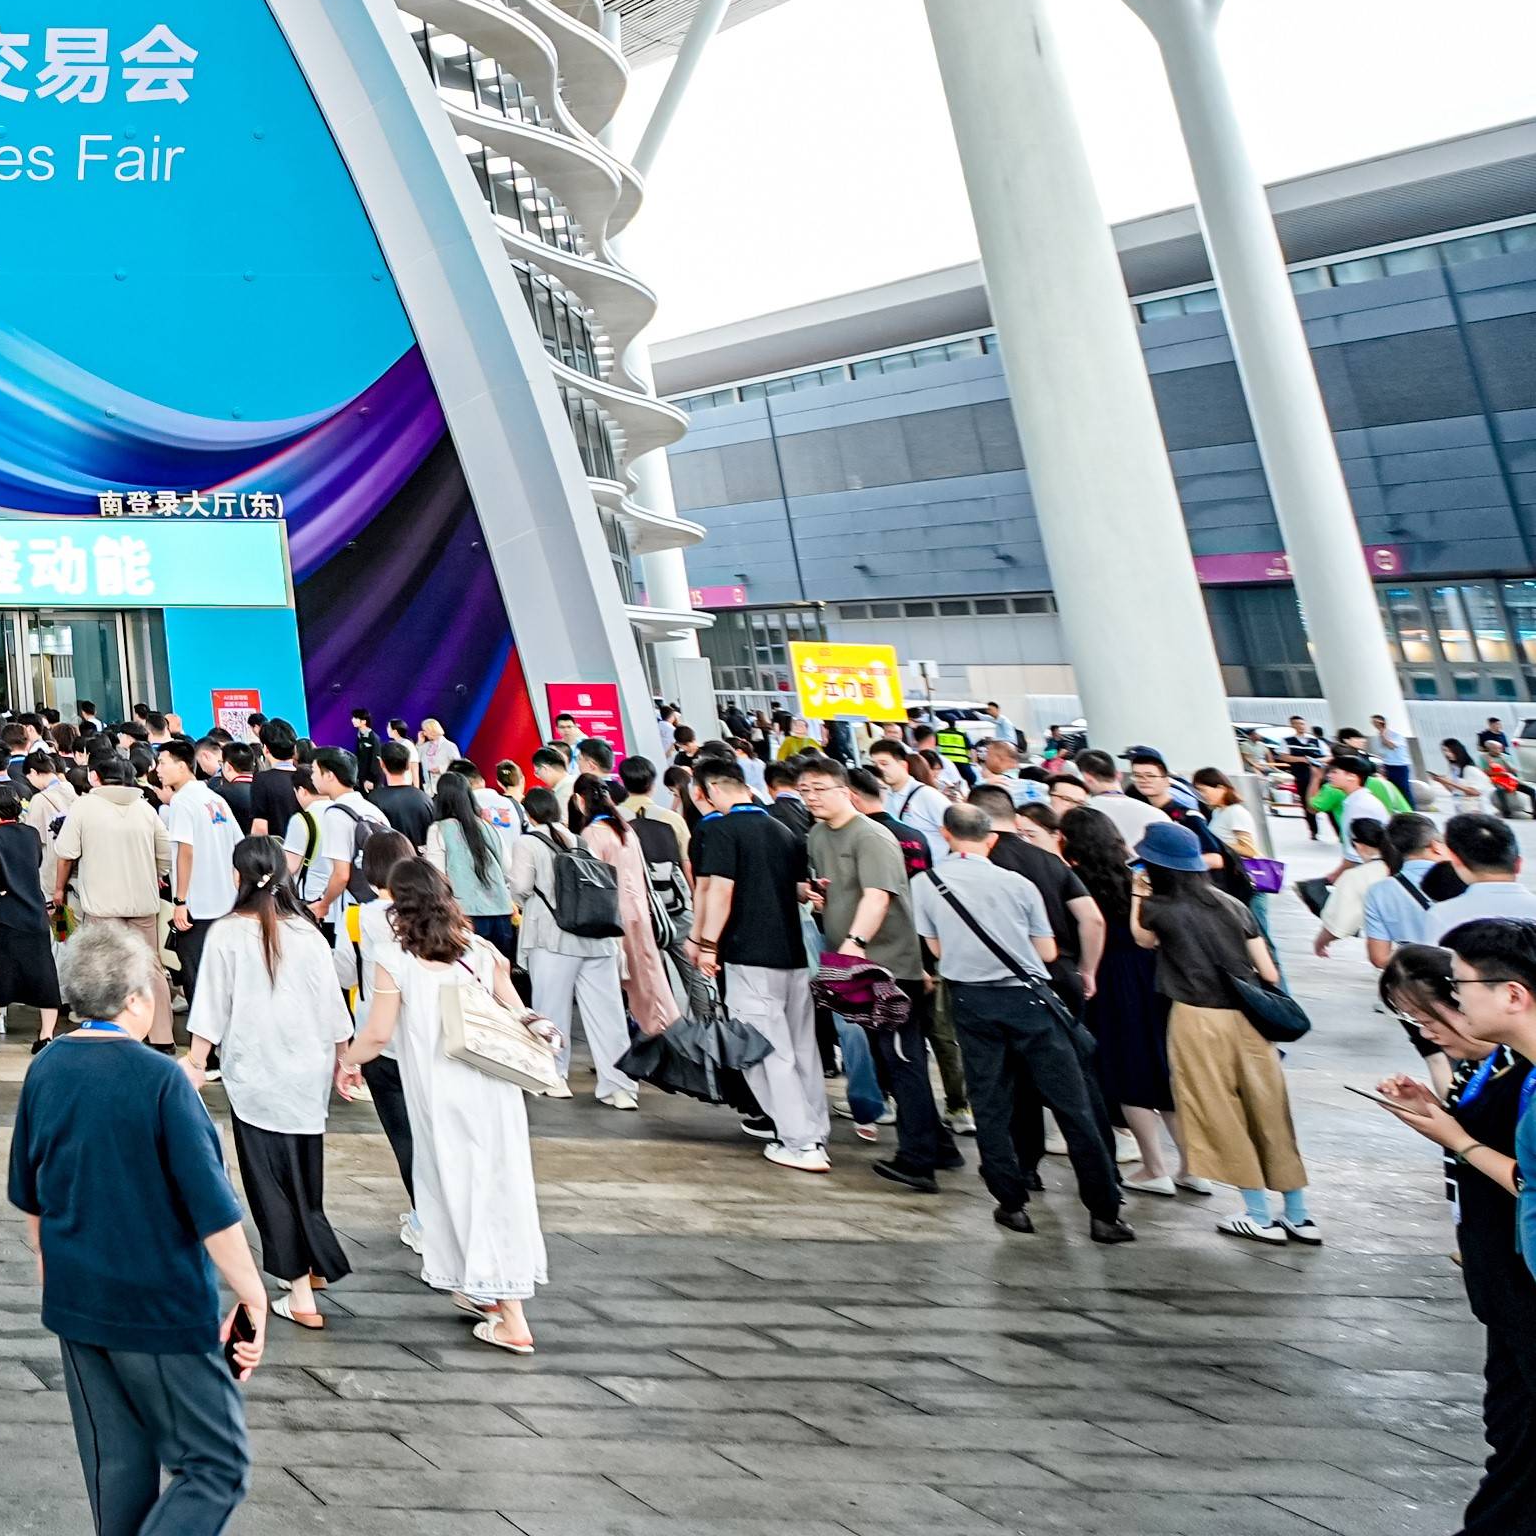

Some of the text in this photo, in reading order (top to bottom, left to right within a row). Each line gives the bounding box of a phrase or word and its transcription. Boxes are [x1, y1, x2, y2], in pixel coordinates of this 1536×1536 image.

[77, 134, 185, 182] Fair
[98, 489, 285, 519] 南登录大厅(东)
